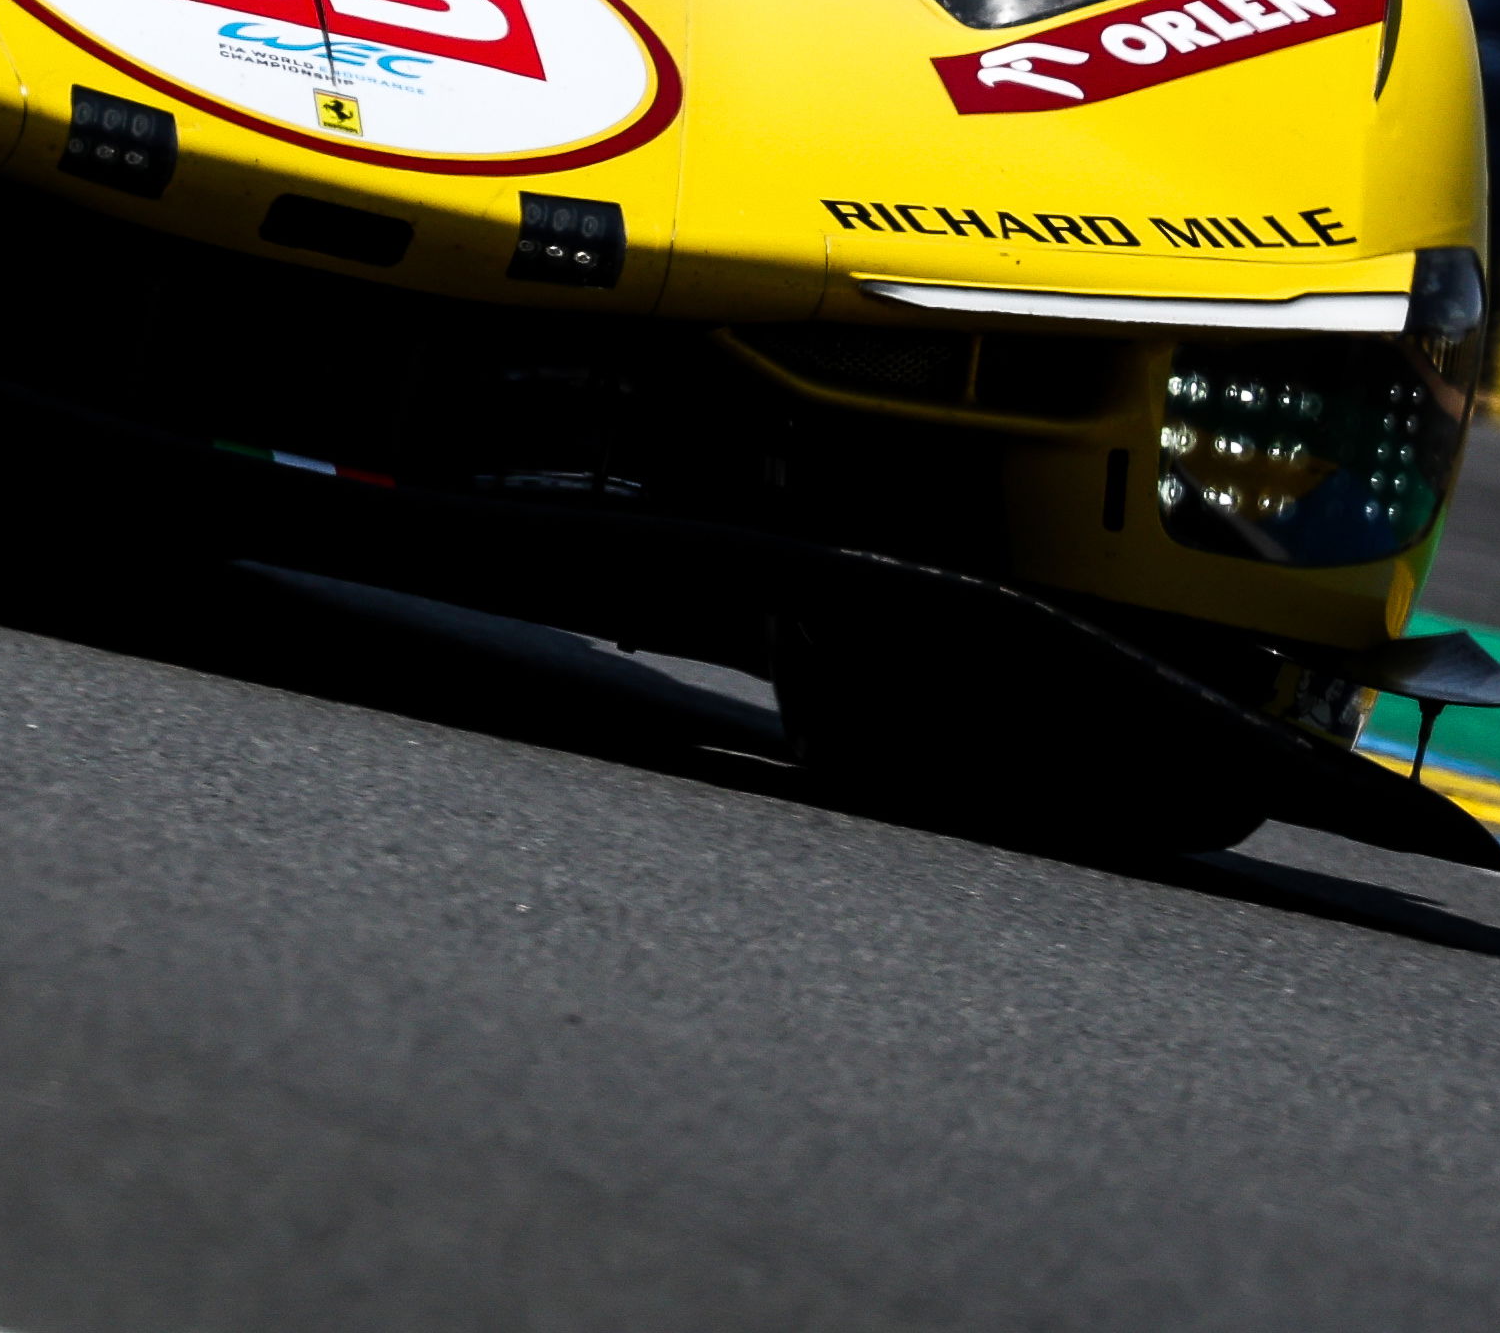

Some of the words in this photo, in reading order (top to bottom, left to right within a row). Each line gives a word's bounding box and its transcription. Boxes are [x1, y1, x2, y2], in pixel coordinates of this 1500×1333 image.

[250, 49, 314, 70] WORLD
[820, 199, 1142, 248] RICHARD
[1149, 206, 1358, 249] MILLE
